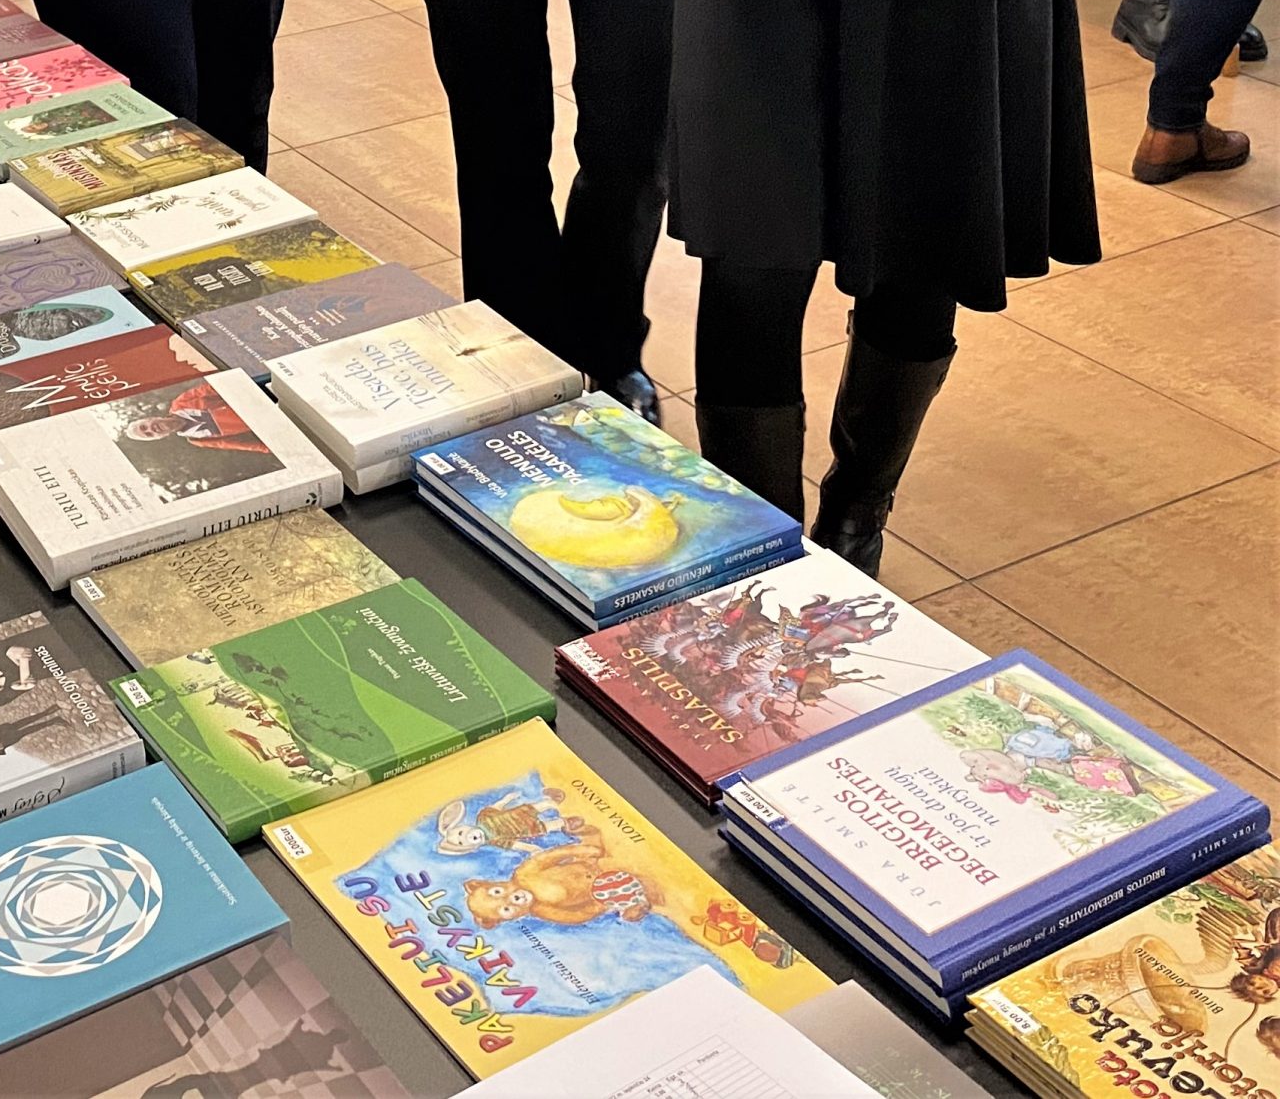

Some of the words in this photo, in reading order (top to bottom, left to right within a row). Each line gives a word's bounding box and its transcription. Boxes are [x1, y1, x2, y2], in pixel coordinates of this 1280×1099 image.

[350, 343, 397, 372] bus
[379, 336, 465, 399] Amerika
[31, 463, 61, 490] EITI
[445, 449, 494, 484] Bladykaitė
[481, 436, 558, 489] MĖNULIO
[501, 428, 589, 487] PASAKĖLĖS
[51, 490, 90, 529] TURIU
[483, 481, 510, 498] Vida
[200, 518, 232, 537] EITI
[764, 535, 782, 551] Vida
[176, 548, 241, 611] ROMANAS
[191, 545, 266, 618] AŠTUONIOLIKTA
[204, 540, 254, 584] KNYGA
[665, 561, 712, 590] MĖNULIO
[168, 558, 236, 628] VIENUOLIKTAS
[612, 579, 666, 610] PASAKĖLĖS
[354, 605, 422, 656] žvangučiai
[34, 645, 75, 698] gyvenimas
[405, 654, 469, 705] Lietuviški
[70, 692, 99, 727] Tenoro
[619, 644, 744, 746] SALASPILIS
[570, 778, 612, 812] TANNO
[752, 800, 775, 820] 14,00
[879, 763, 950, 814] draugų
[915, 763, 1004, 828] nuotykiai
[607, 812, 645, 843] ILONA
[779, 782, 869, 849] SMILTĖ
[825, 754, 998, 886] BEGEMOTAITĖS
[831, 787, 944, 871] BRIGITOS
[940, 809, 980, 835] jos
[1230, 820, 1258, 842] JŪRA
[280, 827, 307, 860] 2,00Eur
[1188, 835, 1228, 862] SMILTĖ
[343, 873, 391, 918] SU
[874, 858, 944, 909] JŪRA
[1125, 865, 1167, 895] BRIGITOS
[1056, 887, 1125, 931] BEGEMOTAITĖS
[394, 870, 538, 1008] VAIKYSTE
[514, 924, 556, 960] vaikams
[388, 918, 517, 1054] PAKELIUI
[550, 959, 600, 1005] Eilėraščiai
[1131, 946, 1193, 990] Jonuškaitė
[1009, 1012, 1032, 1031] 8,00
[1186, 987, 1224, 1014] Birutė
